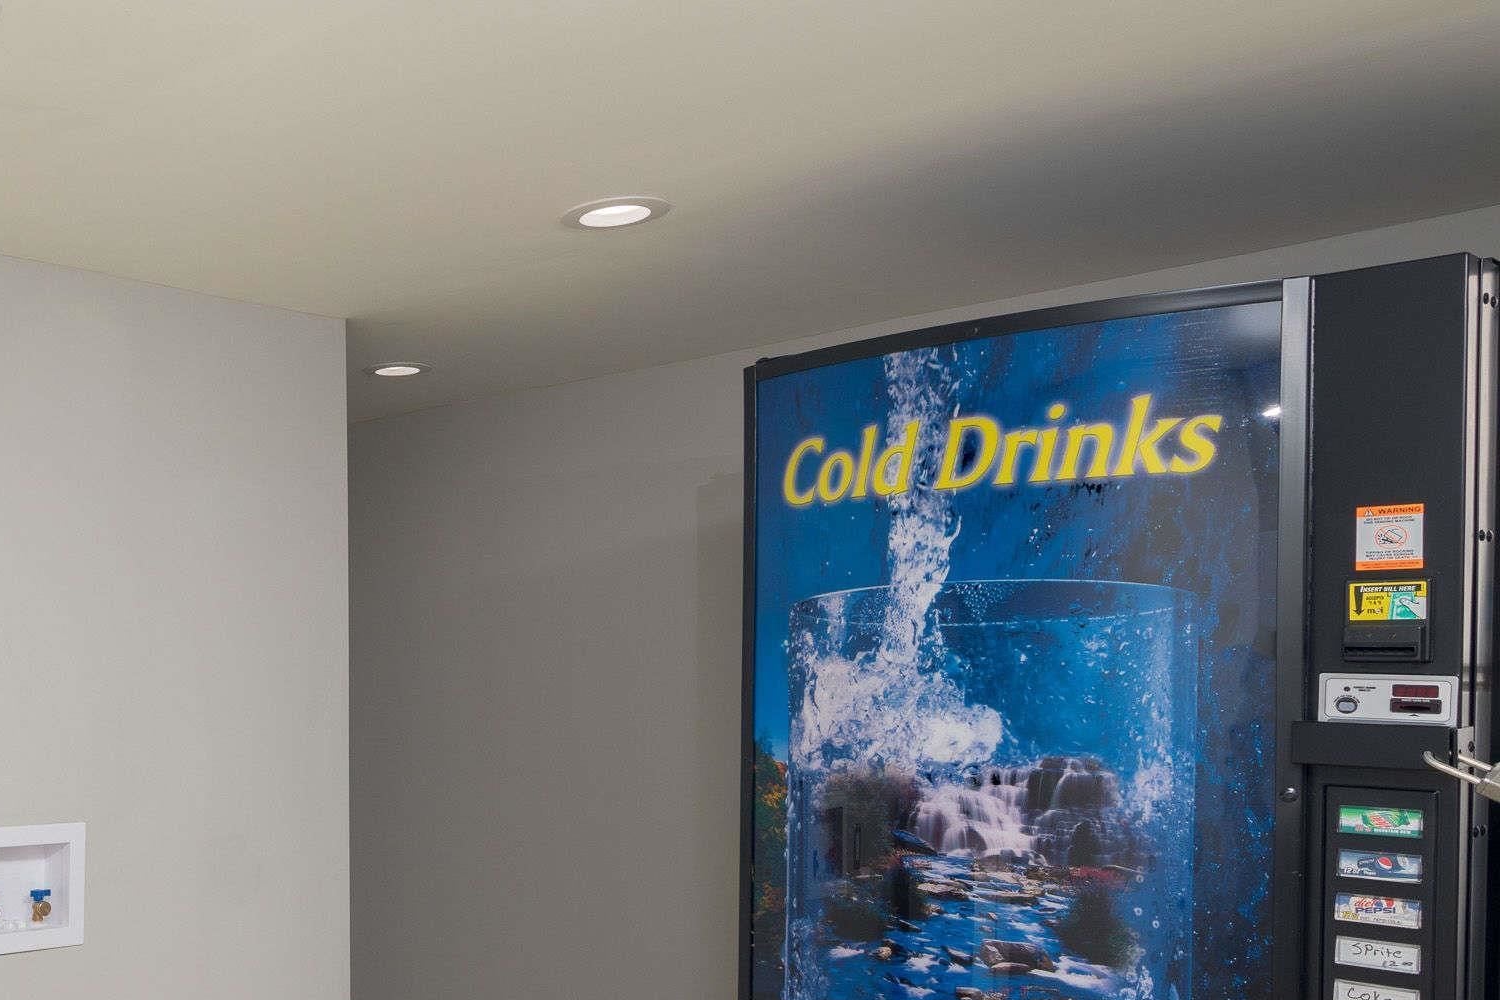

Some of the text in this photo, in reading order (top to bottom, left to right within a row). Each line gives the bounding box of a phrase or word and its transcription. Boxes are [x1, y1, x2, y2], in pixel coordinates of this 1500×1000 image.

[784, 393, 1223, 505] Cold Drinks
[1378, 506, 1421, 515] WARNING
[1360, 585, 1383, 593] INSERT
[1398, 584, 1416, 592] HERE
